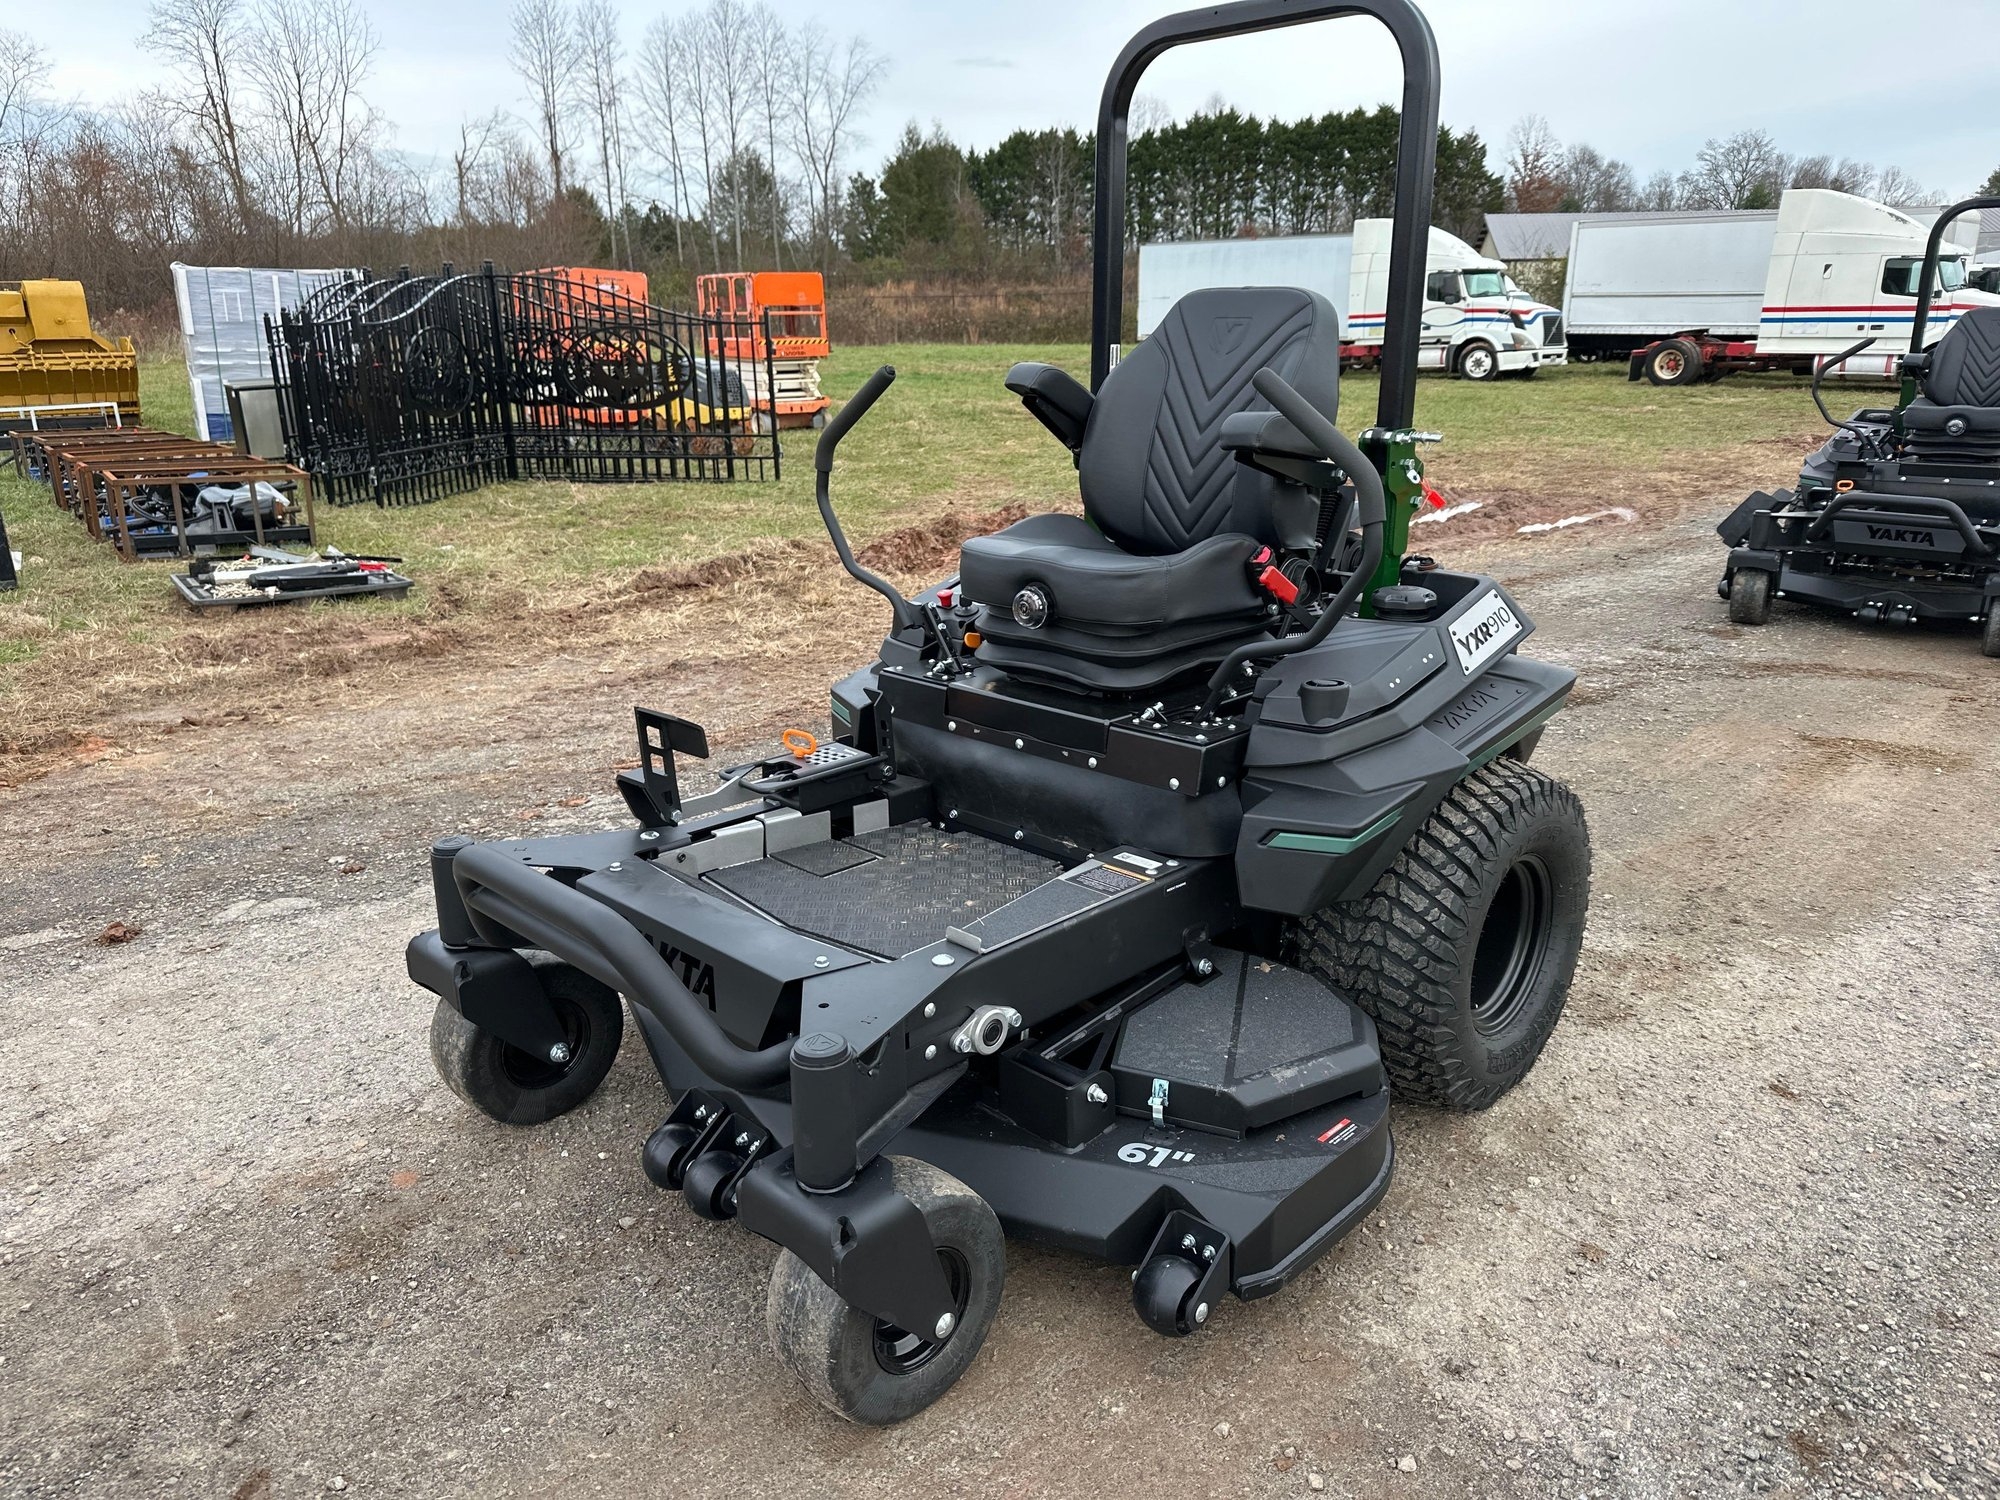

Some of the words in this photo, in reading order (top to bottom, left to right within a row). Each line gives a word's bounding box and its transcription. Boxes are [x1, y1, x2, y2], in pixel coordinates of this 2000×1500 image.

[1866, 524, 1935, 547] YAKTA
[1456, 606, 1511, 656] YXR910
[640, 932, 717, 1013] KTA
[1117, 1142, 1196, 1168] 61"
